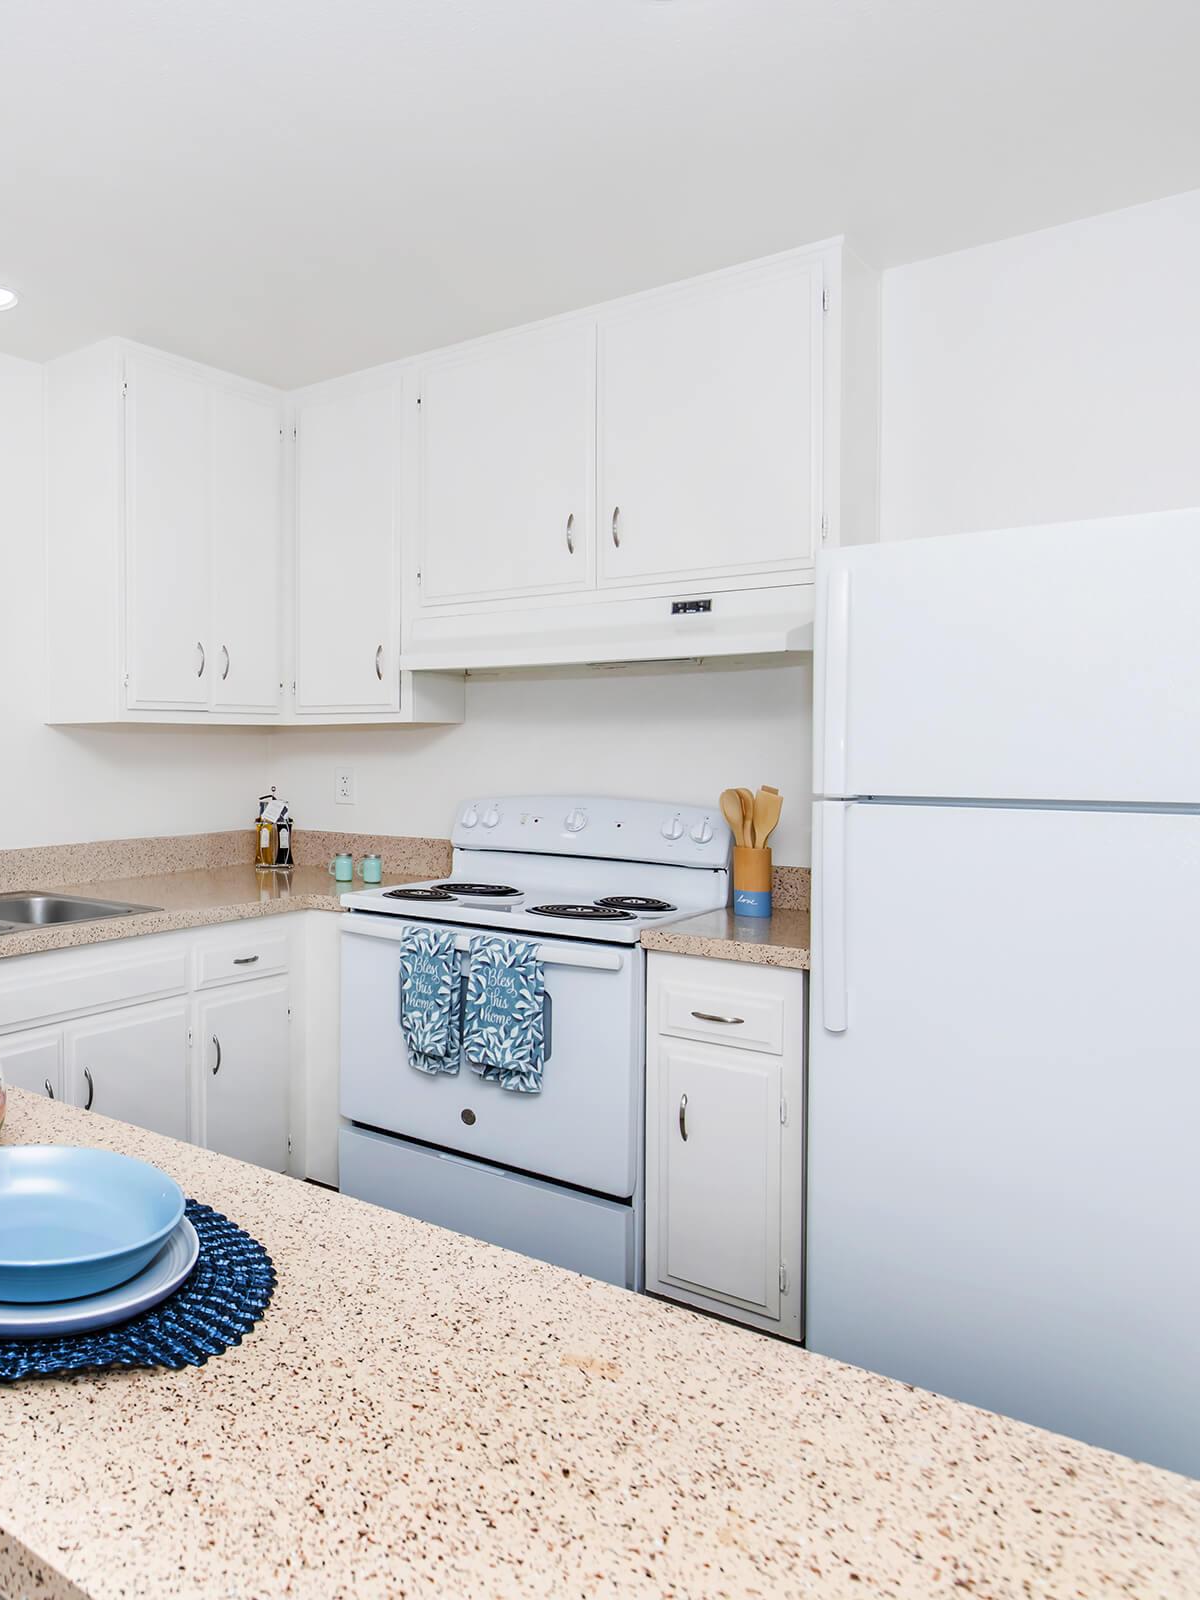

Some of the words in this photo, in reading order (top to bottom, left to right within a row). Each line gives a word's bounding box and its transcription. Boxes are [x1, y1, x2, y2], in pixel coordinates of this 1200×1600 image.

[409, 955, 440, 984] Bless
[411, 975, 433, 994] this
[483, 967, 518, 998] Bless
[406, 993, 435, 1010] home
[485, 988, 509, 1009] this
[480, 1006, 512, 1026] home
